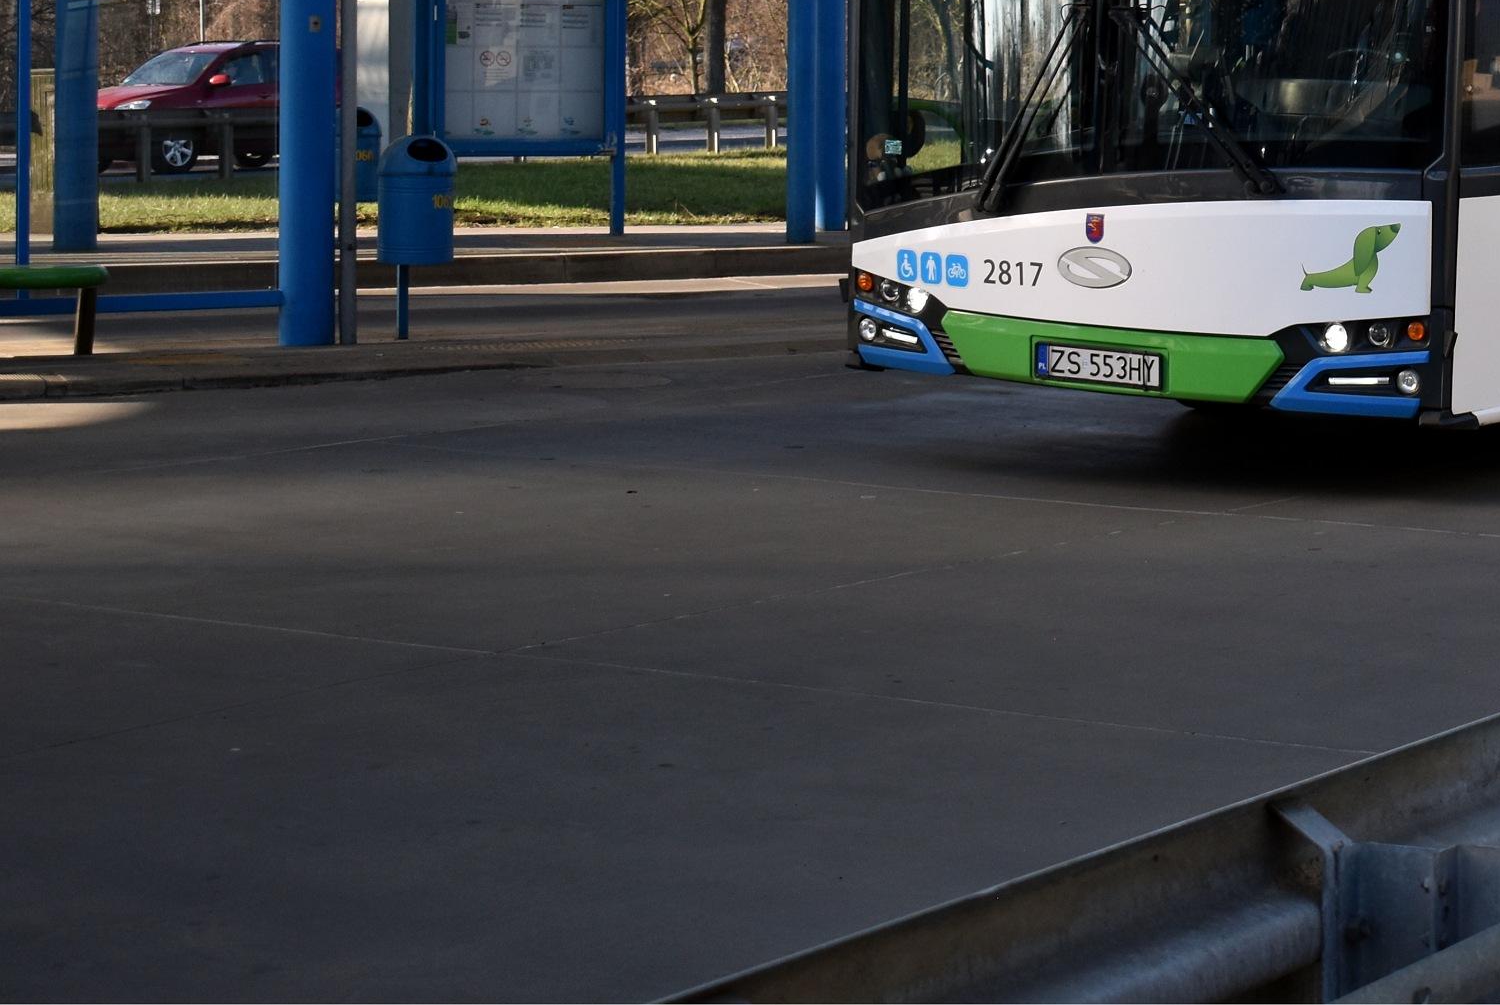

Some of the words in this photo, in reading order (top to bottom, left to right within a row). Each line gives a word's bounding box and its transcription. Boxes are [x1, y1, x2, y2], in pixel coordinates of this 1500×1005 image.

[983, 258, 1043, 287] 2817
[1038, 362, 1047, 370] PL
[1050, 349, 1081, 375] ZS
[1089, 353, 1155, 383] 553HY
